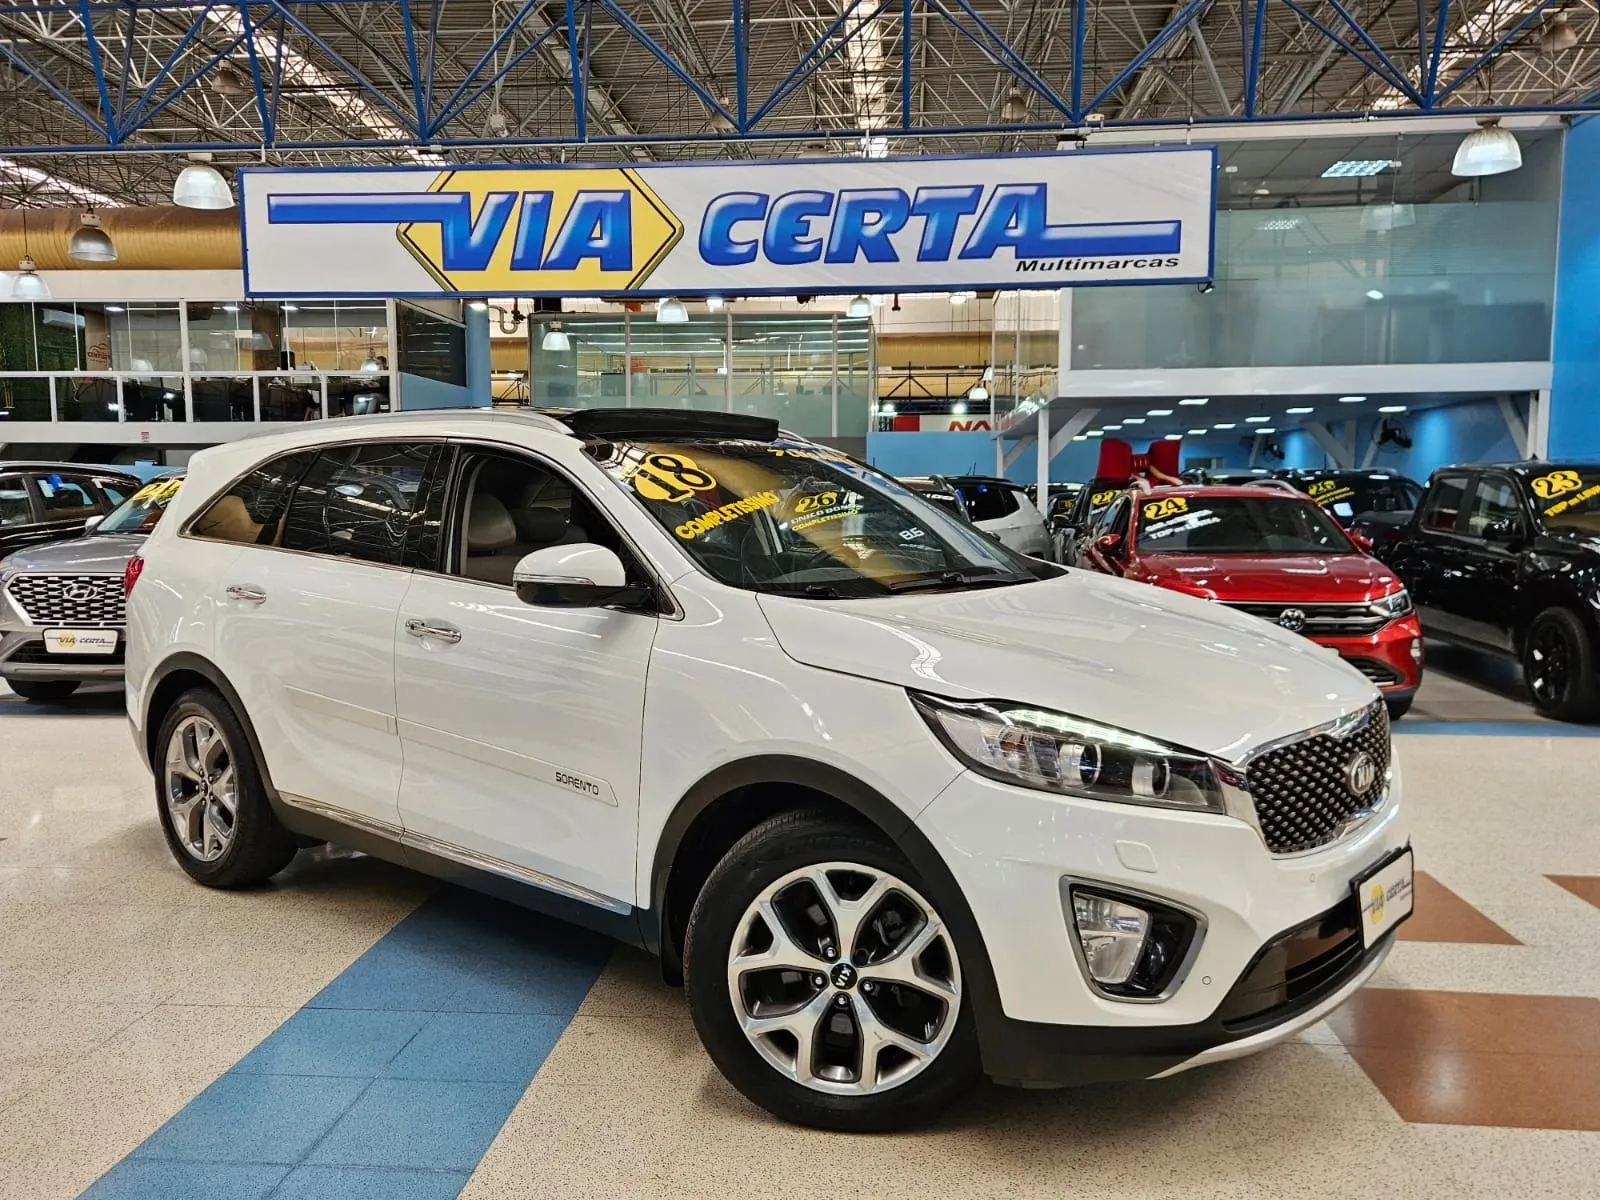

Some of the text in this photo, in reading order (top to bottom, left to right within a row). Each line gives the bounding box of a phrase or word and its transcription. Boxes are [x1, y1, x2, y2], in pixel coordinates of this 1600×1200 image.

[268, 182, 1181, 272] VIA CERTA
[1015, 256, 1181, 273] Multimarcas
[636, 455, 713, 500] 18
[1532, 471, 1582, 499] 23
[795, 491, 838, 513] 26
[1144, 497, 1189, 519] 24
[555, 771, 599, 796] SORENTO
